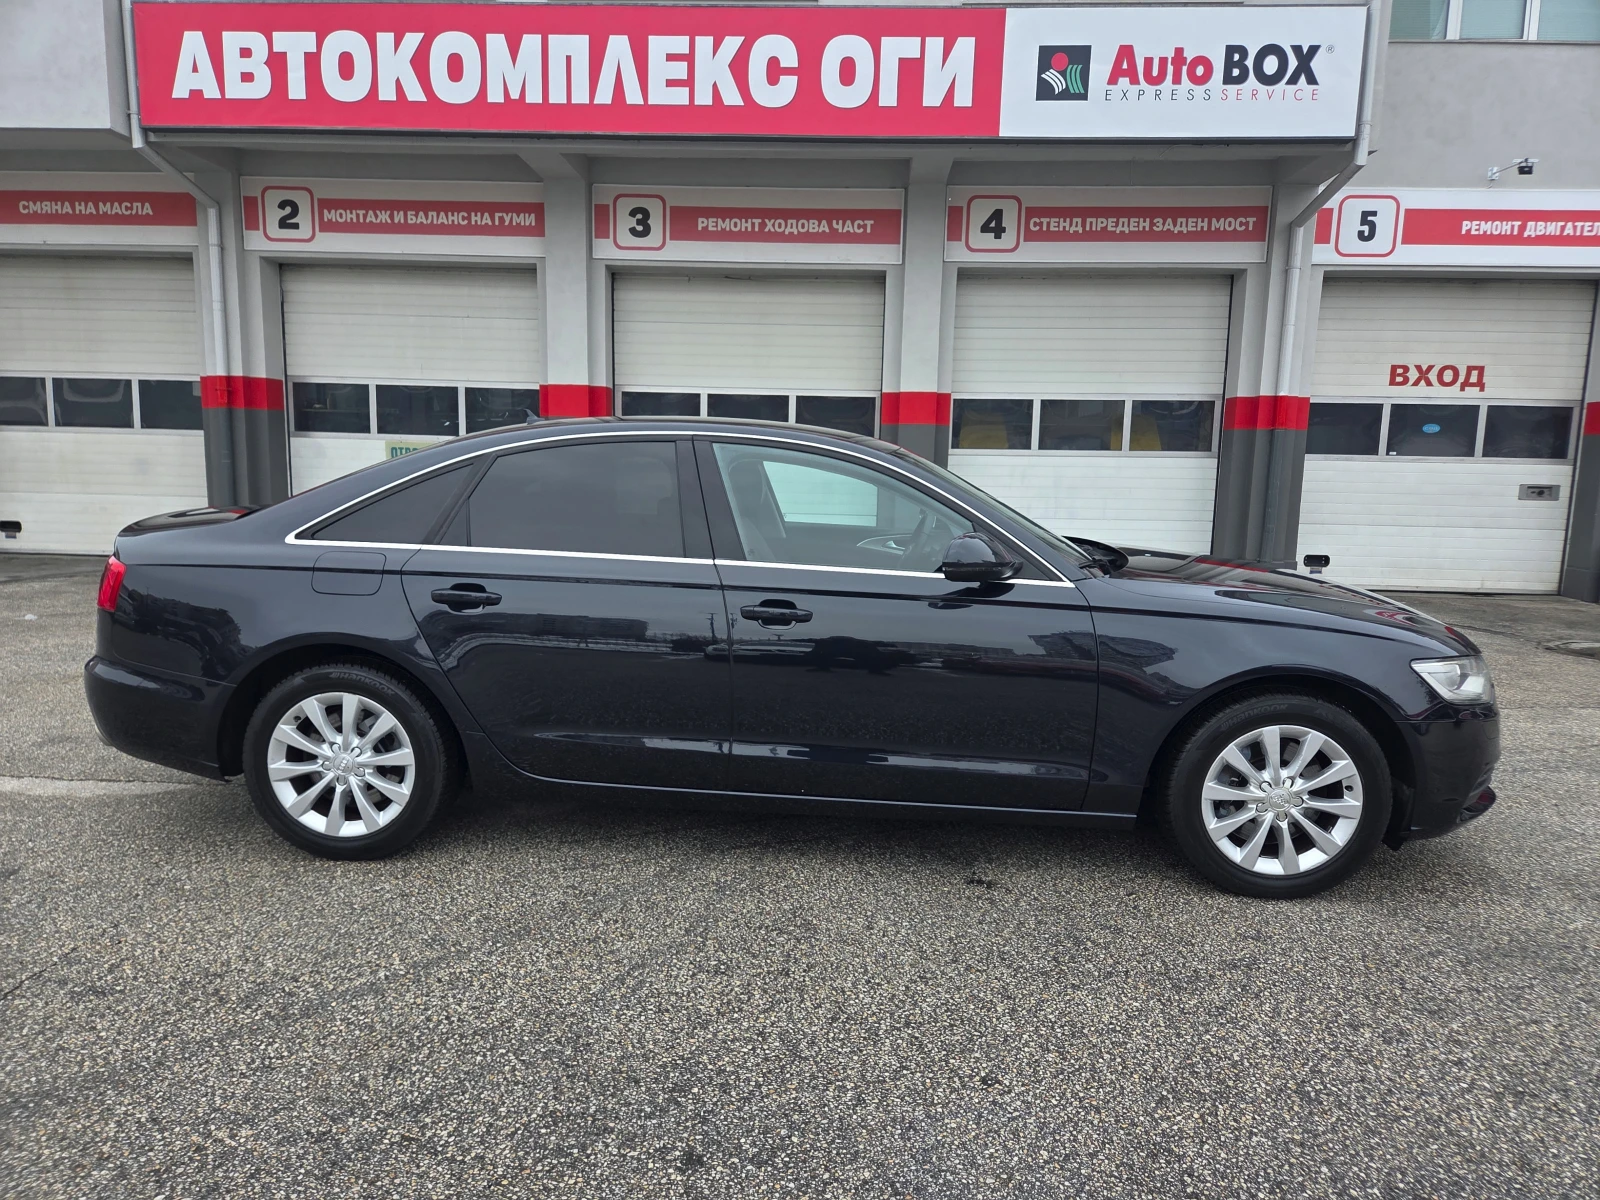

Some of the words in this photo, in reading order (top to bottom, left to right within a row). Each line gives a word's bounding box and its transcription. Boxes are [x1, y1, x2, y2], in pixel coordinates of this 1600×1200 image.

[171, 29, 799, 109] АВТОКОМПЛЕКС
[820, 34, 976, 109] ОГИ
[1106, 44, 1214, 87] Auto
[1222, 43, 1322, 87] BOX
[1104, 88, 1212, 102] EXPRESS
[1220, 88, 1319, 102] SERVICE
[18, 200, 73, 214] СМЯНА
[75, 201, 96, 215] НА
[99, 202, 153, 216] МАСЛА
[277, 199, 300, 230] 2
[323, 208, 392, 224] МОНТАЖ
[393, 210, 405, 224] И
[407, 210, 468, 226] БАЛАНС
[471, 212, 492, 226] НА
[494, 212, 536, 227] ГУМИ
[628, 206, 652, 239] 3
[697, 217, 762, 232] РЕМОНТ
[764, 218, 830, 234] ХОДОВА
[832, 219, 874, 234] ЧАСТ
[979, 208, 1007, 240] 4
[1029, 217, 1083, 234] СТЕНД
[1085, 217, 1150, 234] ПРЕДЕН
[1152, 217, 1208, 234] ЗАДЕН
[1211, 217, 1257, 232] МОСТ
[1356, 210, 1378, 242] 5
[1460, 220, 1522, 235] РЕМОНТ
[1388, 364, 1486, 393] ВХОД
